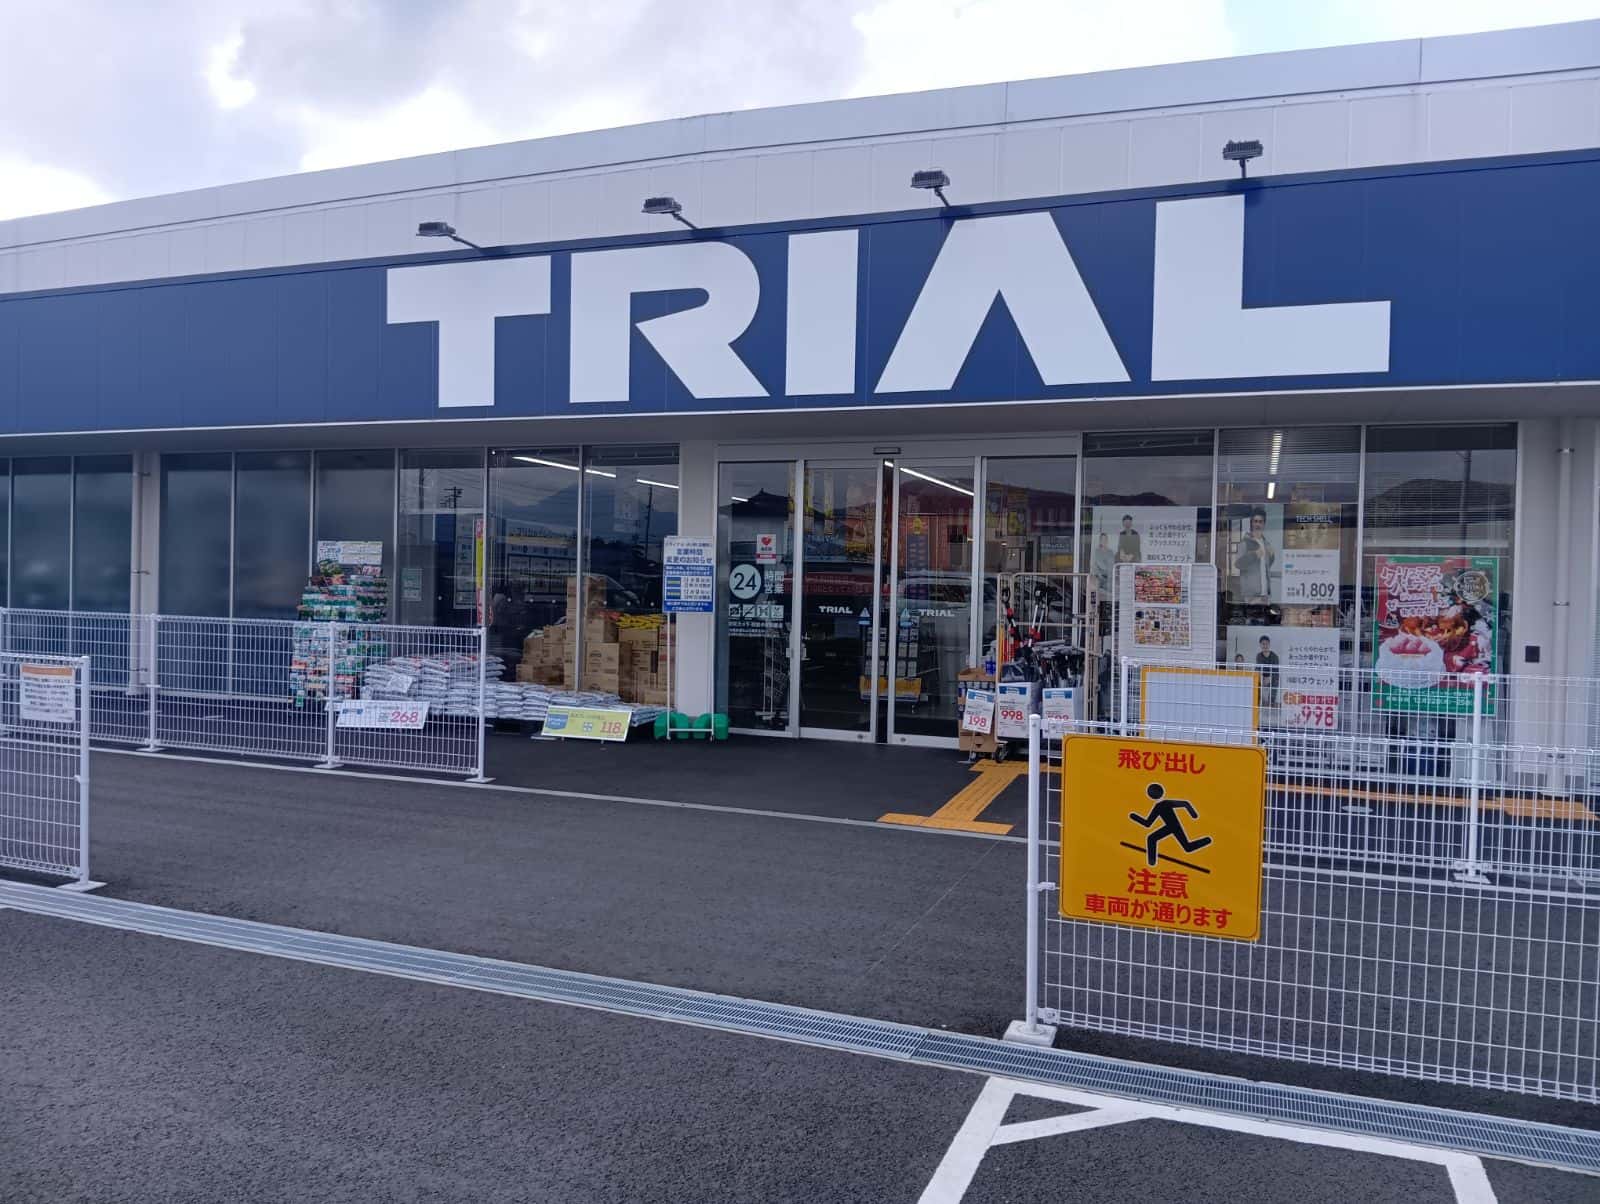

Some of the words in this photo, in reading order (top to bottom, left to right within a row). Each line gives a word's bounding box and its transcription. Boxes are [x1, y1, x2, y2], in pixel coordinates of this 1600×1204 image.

[386, 194, 1392, 409] TRIAL
[733, 572, 757, 591] 24
[764, 571, 785, 581] 時間
[764, 581, 785, 594] 営業
[818, 606, 853, 614] TRIAL
[918, 608, 955, 617] TRIAL
[390, 711, 419, 723] 268
[968, 715, 987, 728] 198
[1001, 710, 1023, 721] 998
[600, 721, 622, 734] 118
[1117, 748, 1206, 775] 飛び出し
[1127, 867, 1189, 899] 注意
[1084, 893, 1233, 929] 車両が通ります
